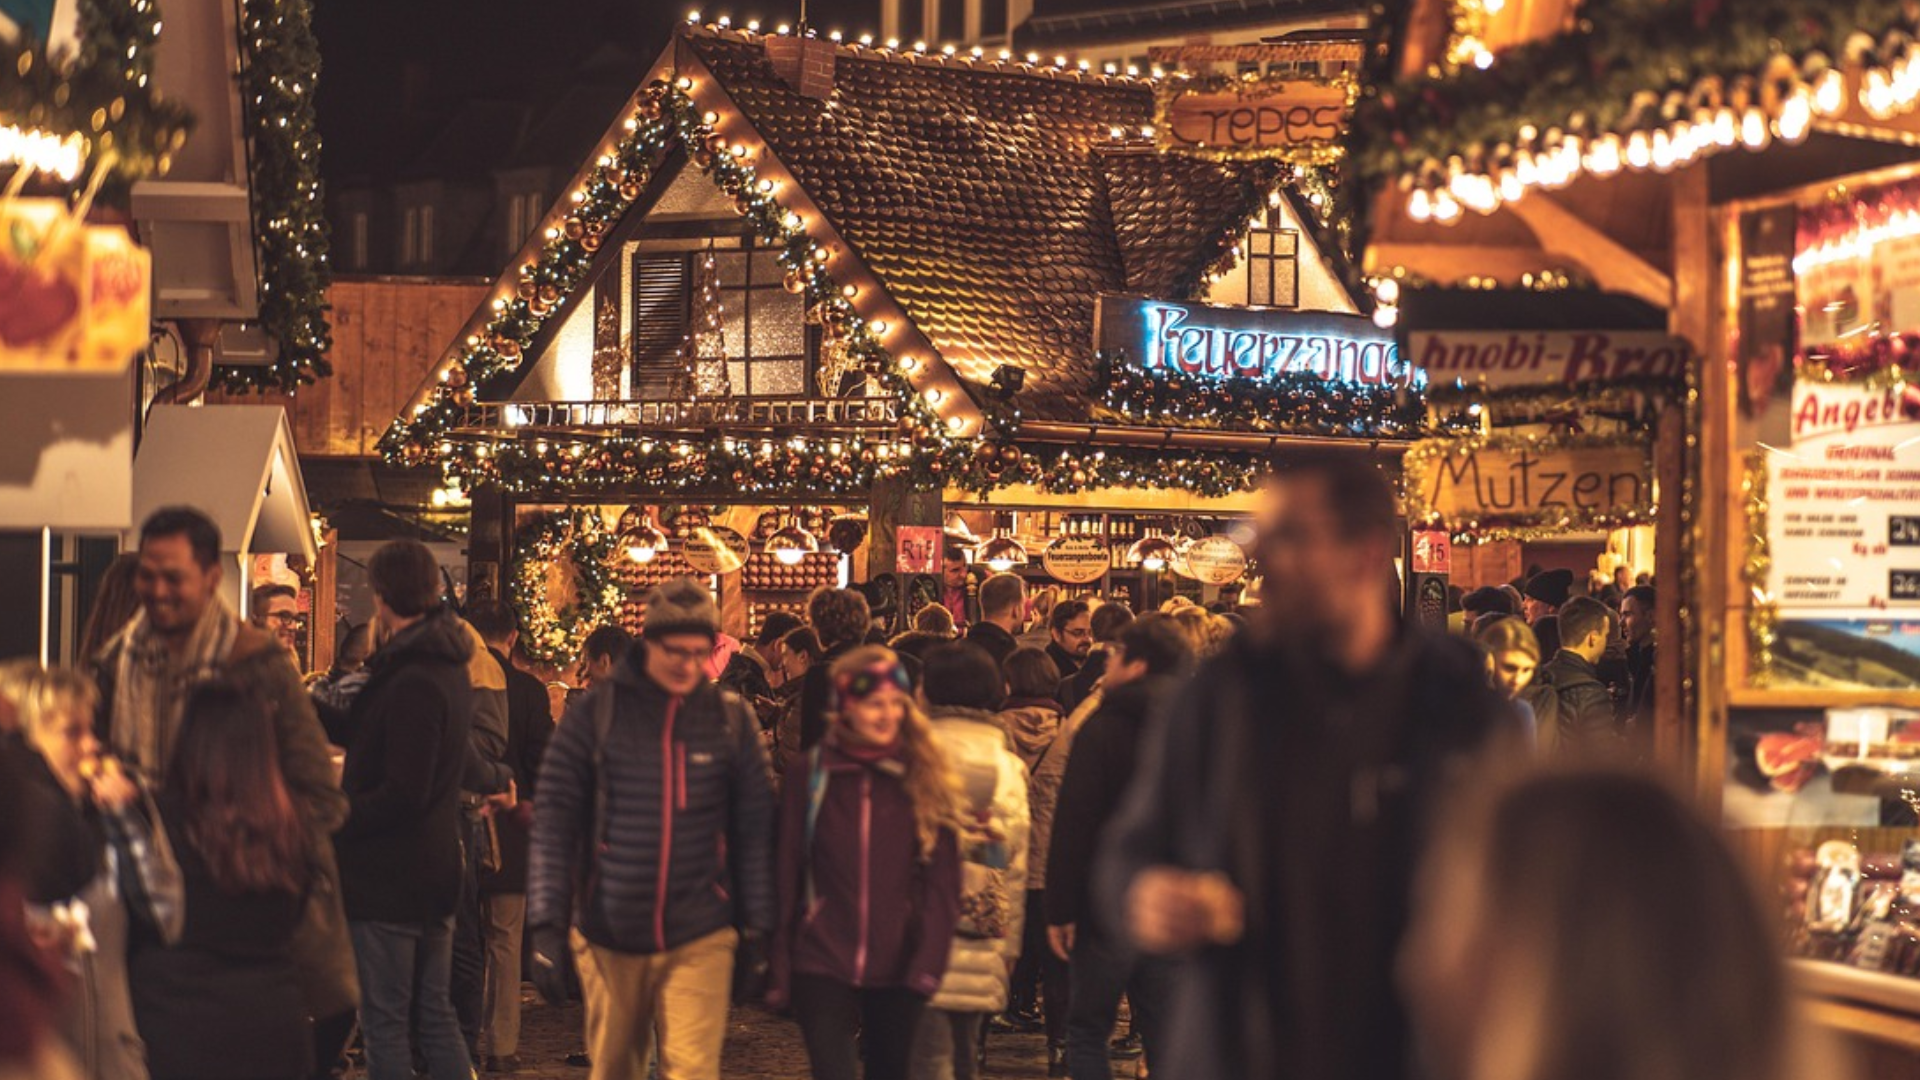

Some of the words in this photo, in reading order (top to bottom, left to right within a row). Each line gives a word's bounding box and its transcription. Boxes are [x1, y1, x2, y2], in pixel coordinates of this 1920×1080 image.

[1170, 91, 1343, 145] Crepes
[1430, 450, 1641, 510] Mutzen
[901, 539, 935, 561] R15
